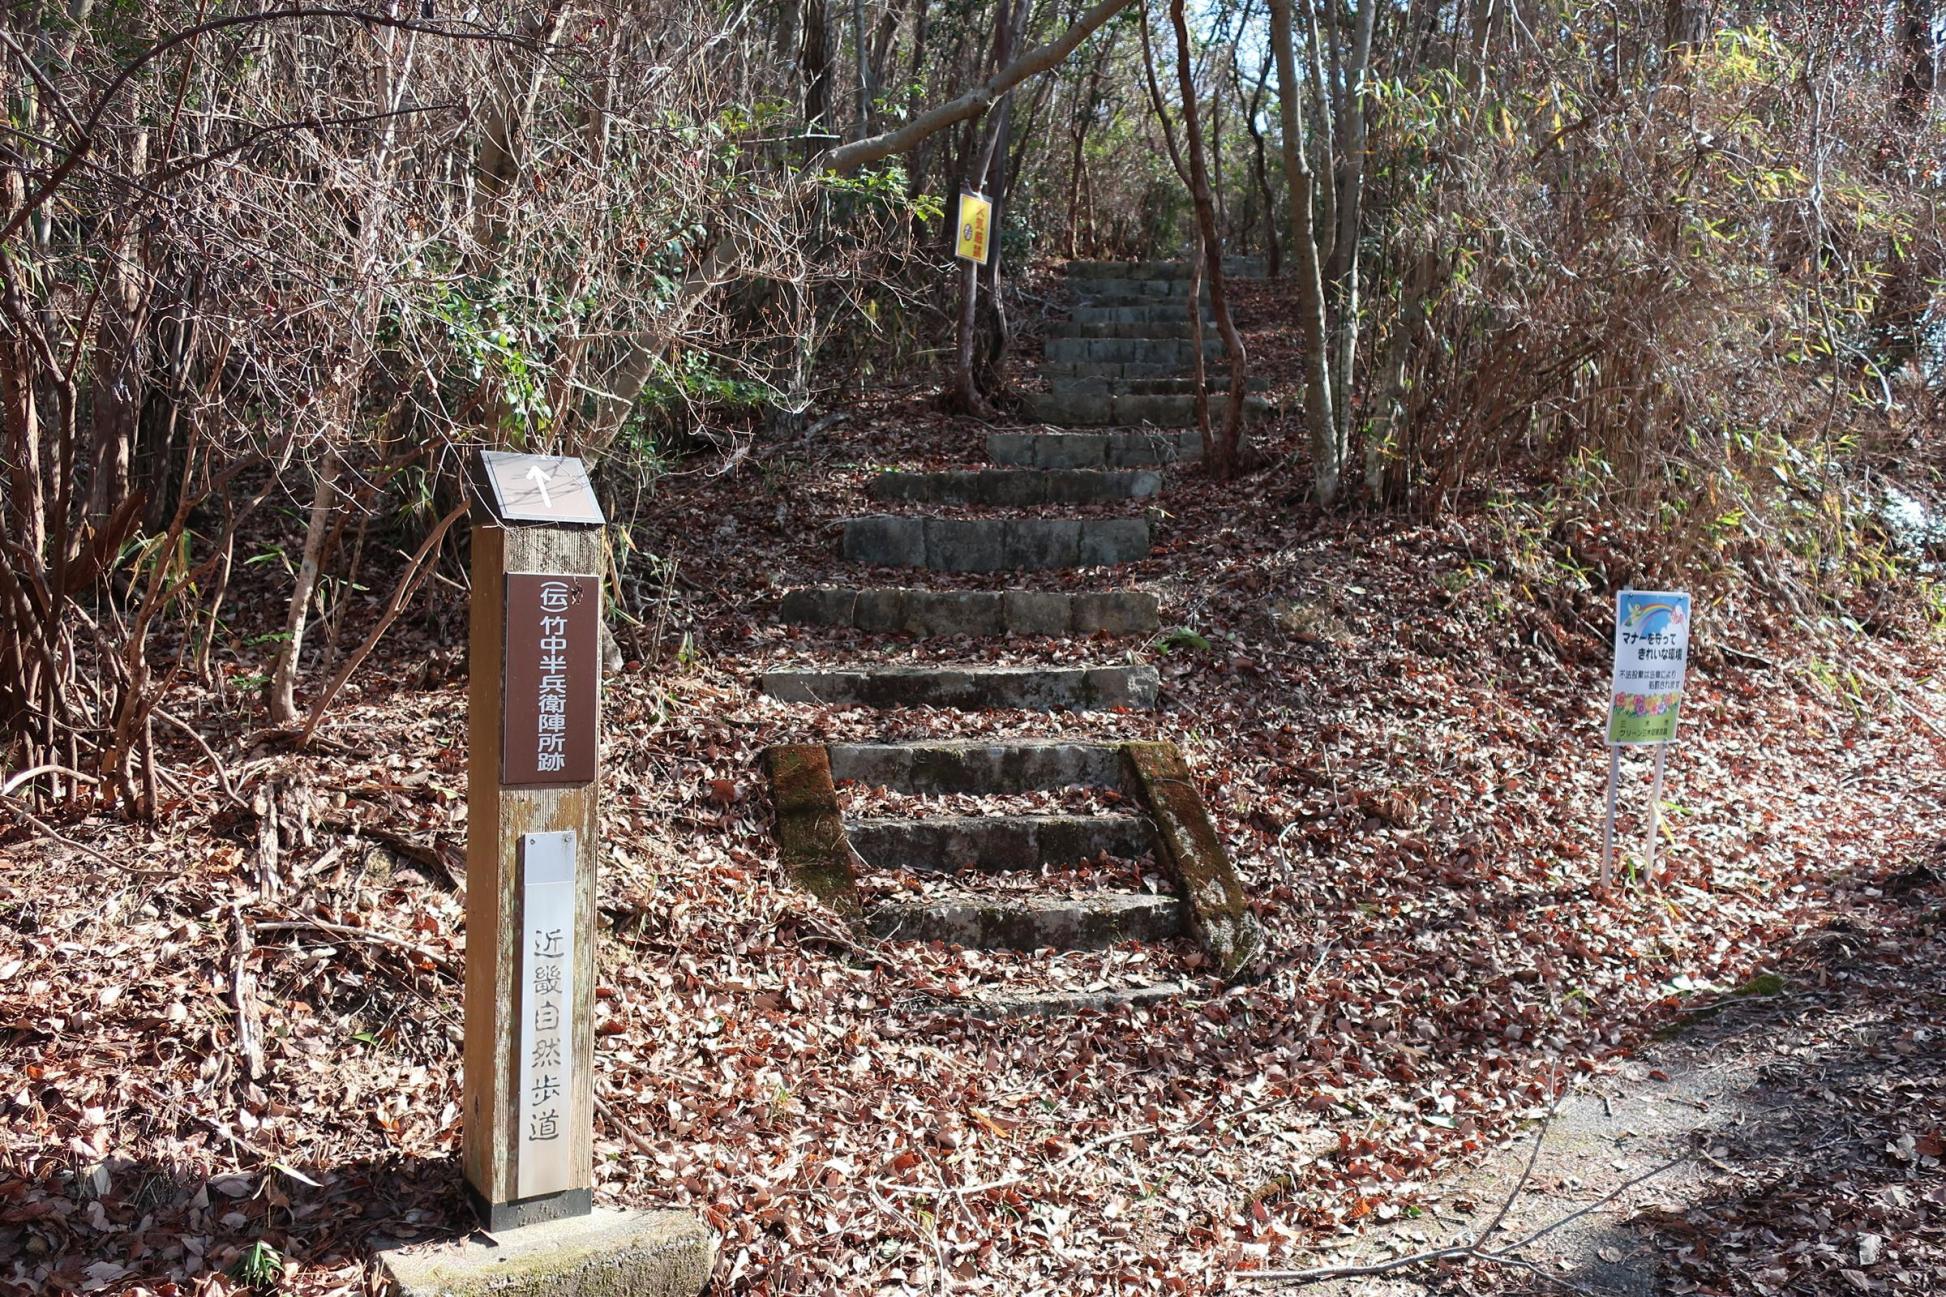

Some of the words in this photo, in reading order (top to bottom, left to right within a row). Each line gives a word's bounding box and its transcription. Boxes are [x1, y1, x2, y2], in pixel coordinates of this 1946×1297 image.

[537, 581, 568, 772] （伝）竹中半兵衛陣所跡
[1622, 632, 1677, 645] マナーを守って
[1638, 648, 1683, 660] きれいな環境
[528, 929, 565, 1142] 近畿自然歩道
